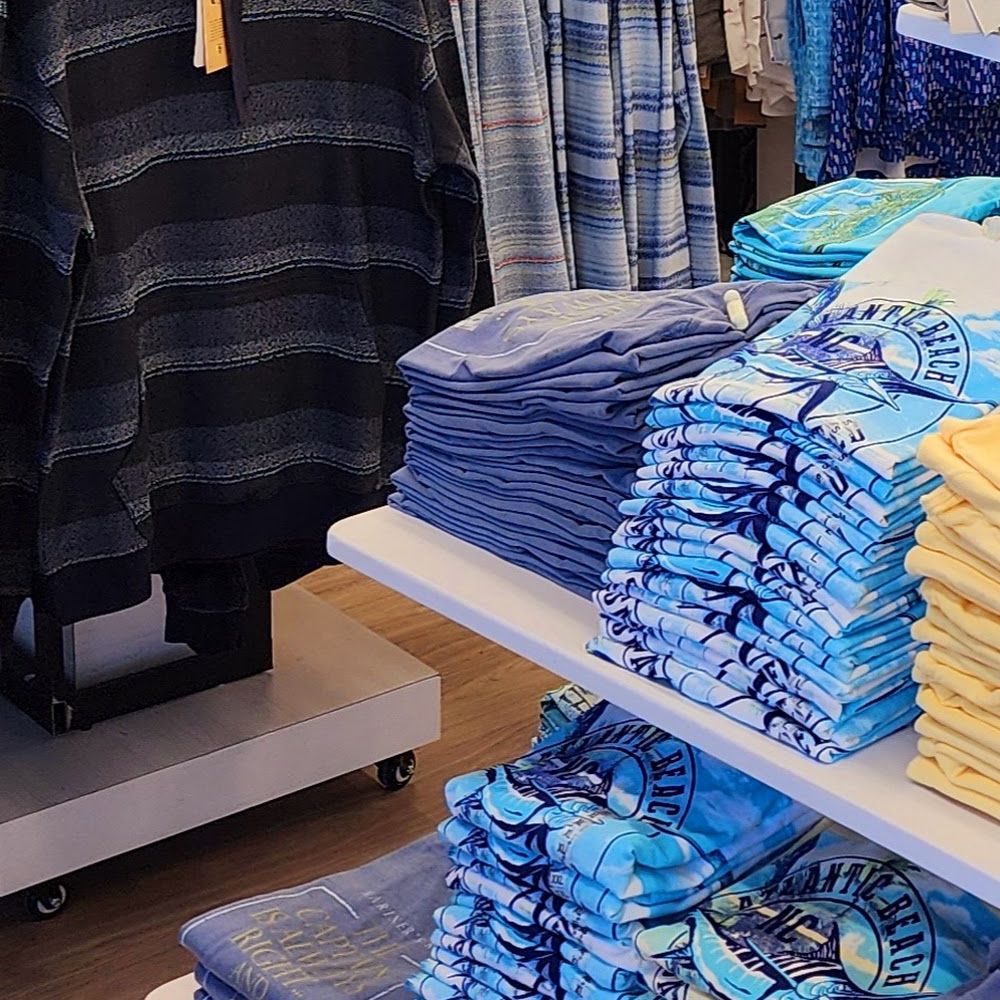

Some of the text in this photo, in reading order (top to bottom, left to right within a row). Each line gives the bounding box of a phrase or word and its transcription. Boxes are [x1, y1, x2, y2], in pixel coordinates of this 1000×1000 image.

[807, 327, 862, 354] NC
[917, 319, 961, 385] BEACH
[296, 906, 391, 980] CAPTAIN
[757, 904, 819, 944] NC
[872, 893, 926, 988] BEACH
[231, 962, 271, 999] AND
